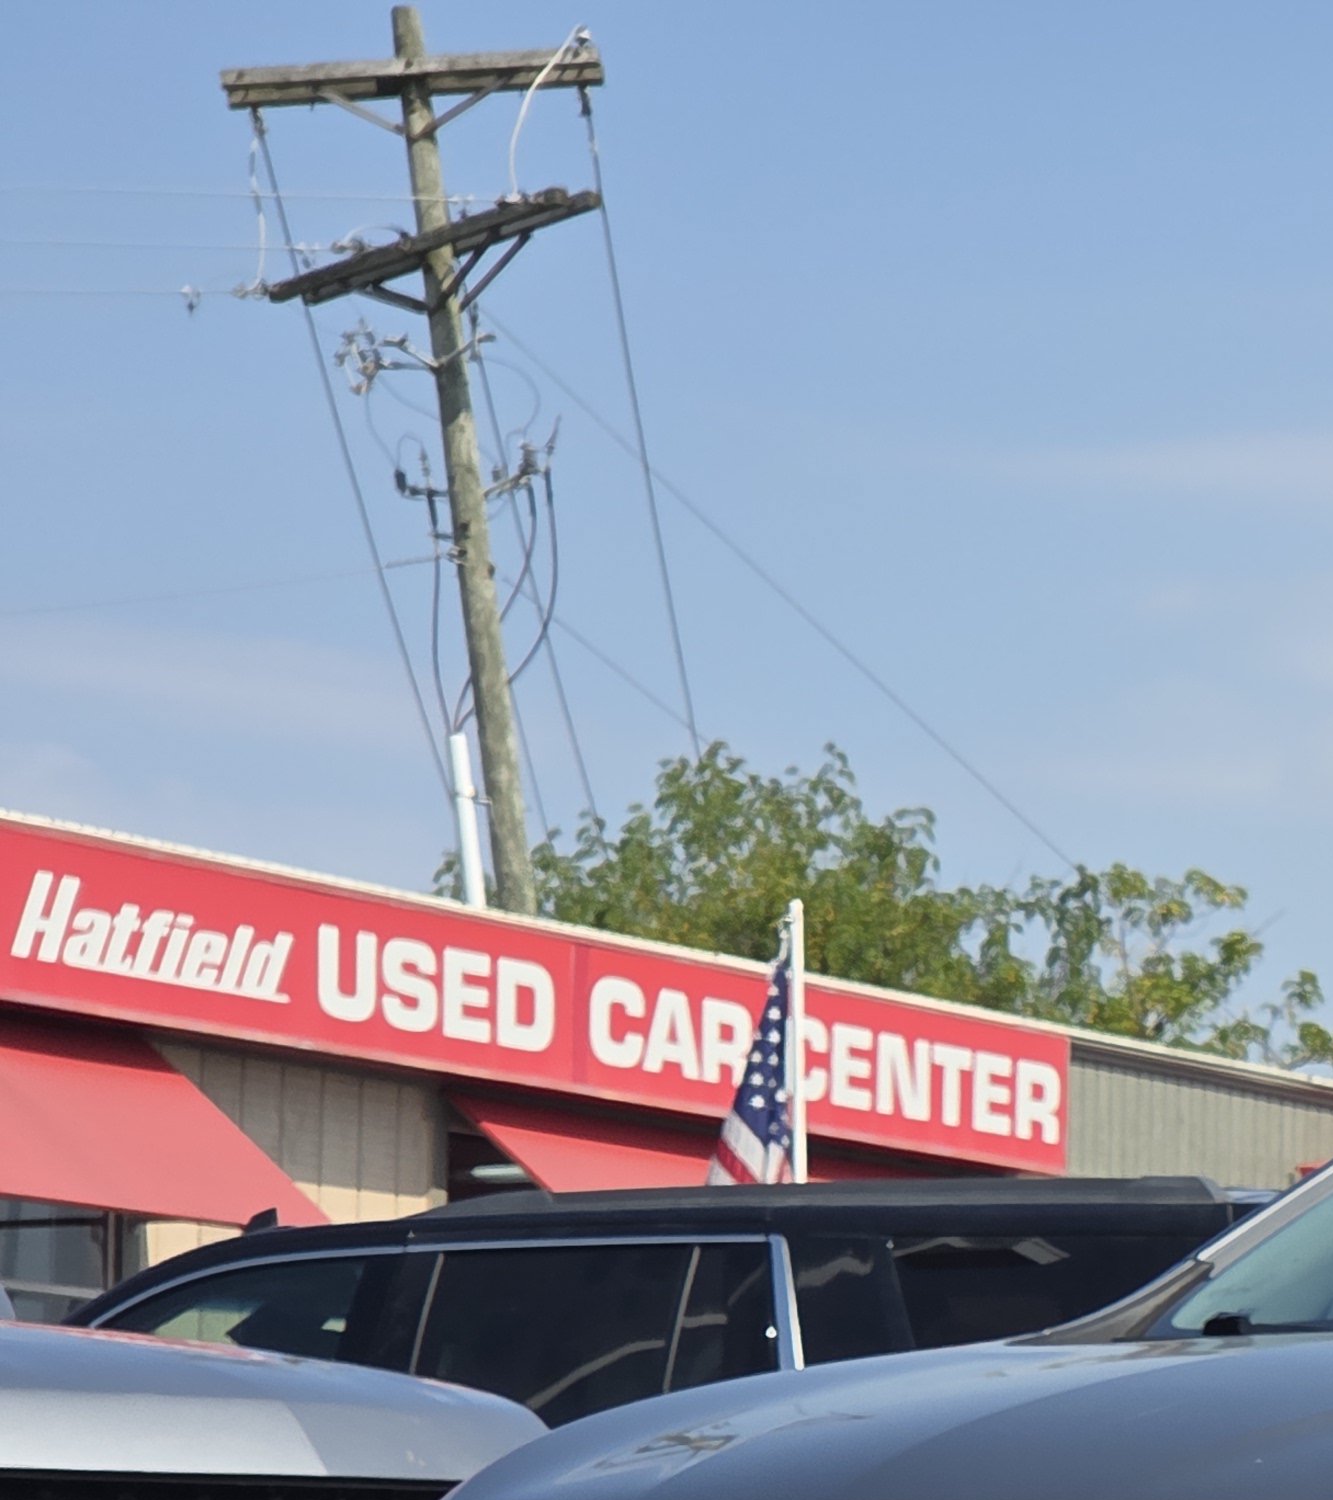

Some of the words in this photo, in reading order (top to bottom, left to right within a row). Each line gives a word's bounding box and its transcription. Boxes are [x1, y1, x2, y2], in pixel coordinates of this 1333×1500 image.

[10, 869, 293, 1004] Hatfield
[317, 923, 555, 1052] USED
[589, 975, 753, 1088] CAR
[785, 1016, 1061, 1145] CENTER
